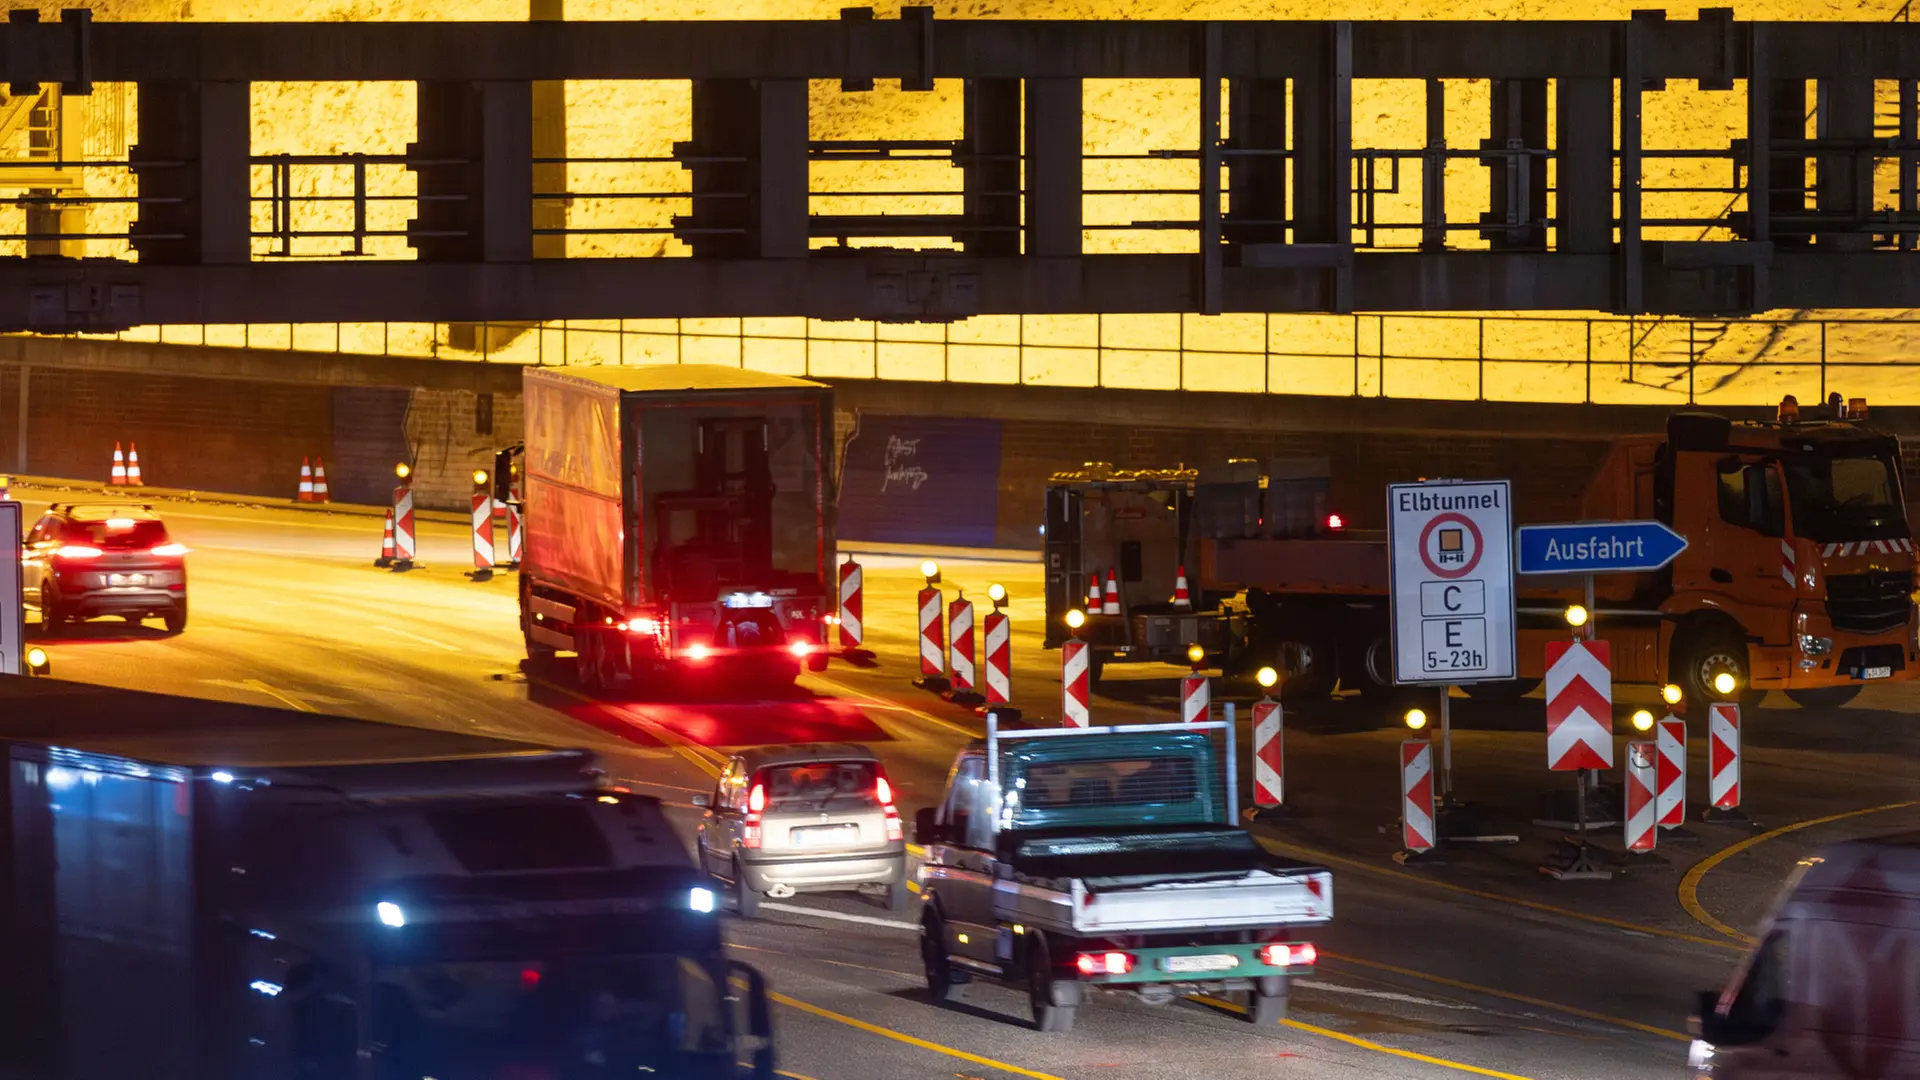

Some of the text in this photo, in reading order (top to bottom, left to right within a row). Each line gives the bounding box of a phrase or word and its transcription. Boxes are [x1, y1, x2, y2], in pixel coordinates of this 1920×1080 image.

[1399, 489, 1500, 512] Elbtunnel
[1544, 535, 1644, 561] Ausfahrt
[1443, 585, 1462, 611] C
[1445, 621, 1463, 648] E
